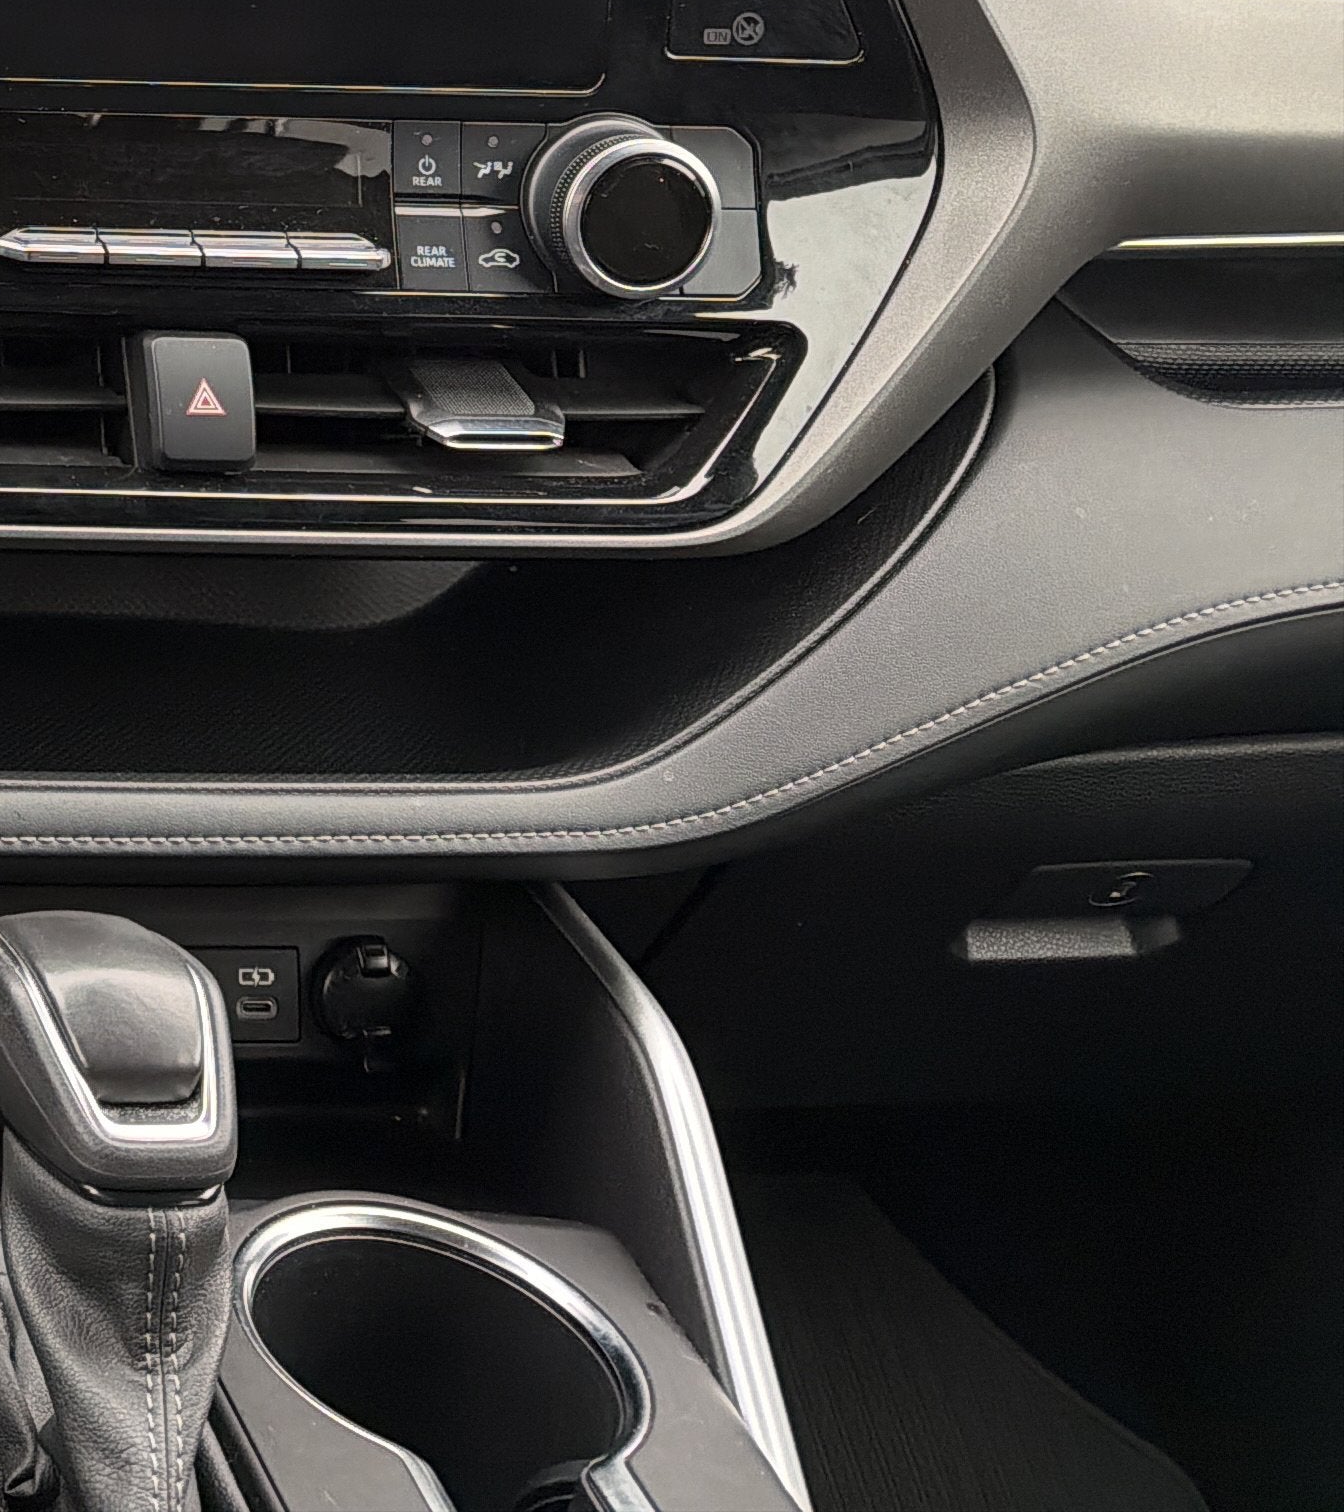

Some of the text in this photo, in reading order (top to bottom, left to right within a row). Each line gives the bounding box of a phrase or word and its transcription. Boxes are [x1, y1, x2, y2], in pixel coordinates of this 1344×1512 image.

[412, 175, 442, 187] REAR
[416, 245, 447, 256] REAR
[410, 255, 456, 268] CLIMATE
